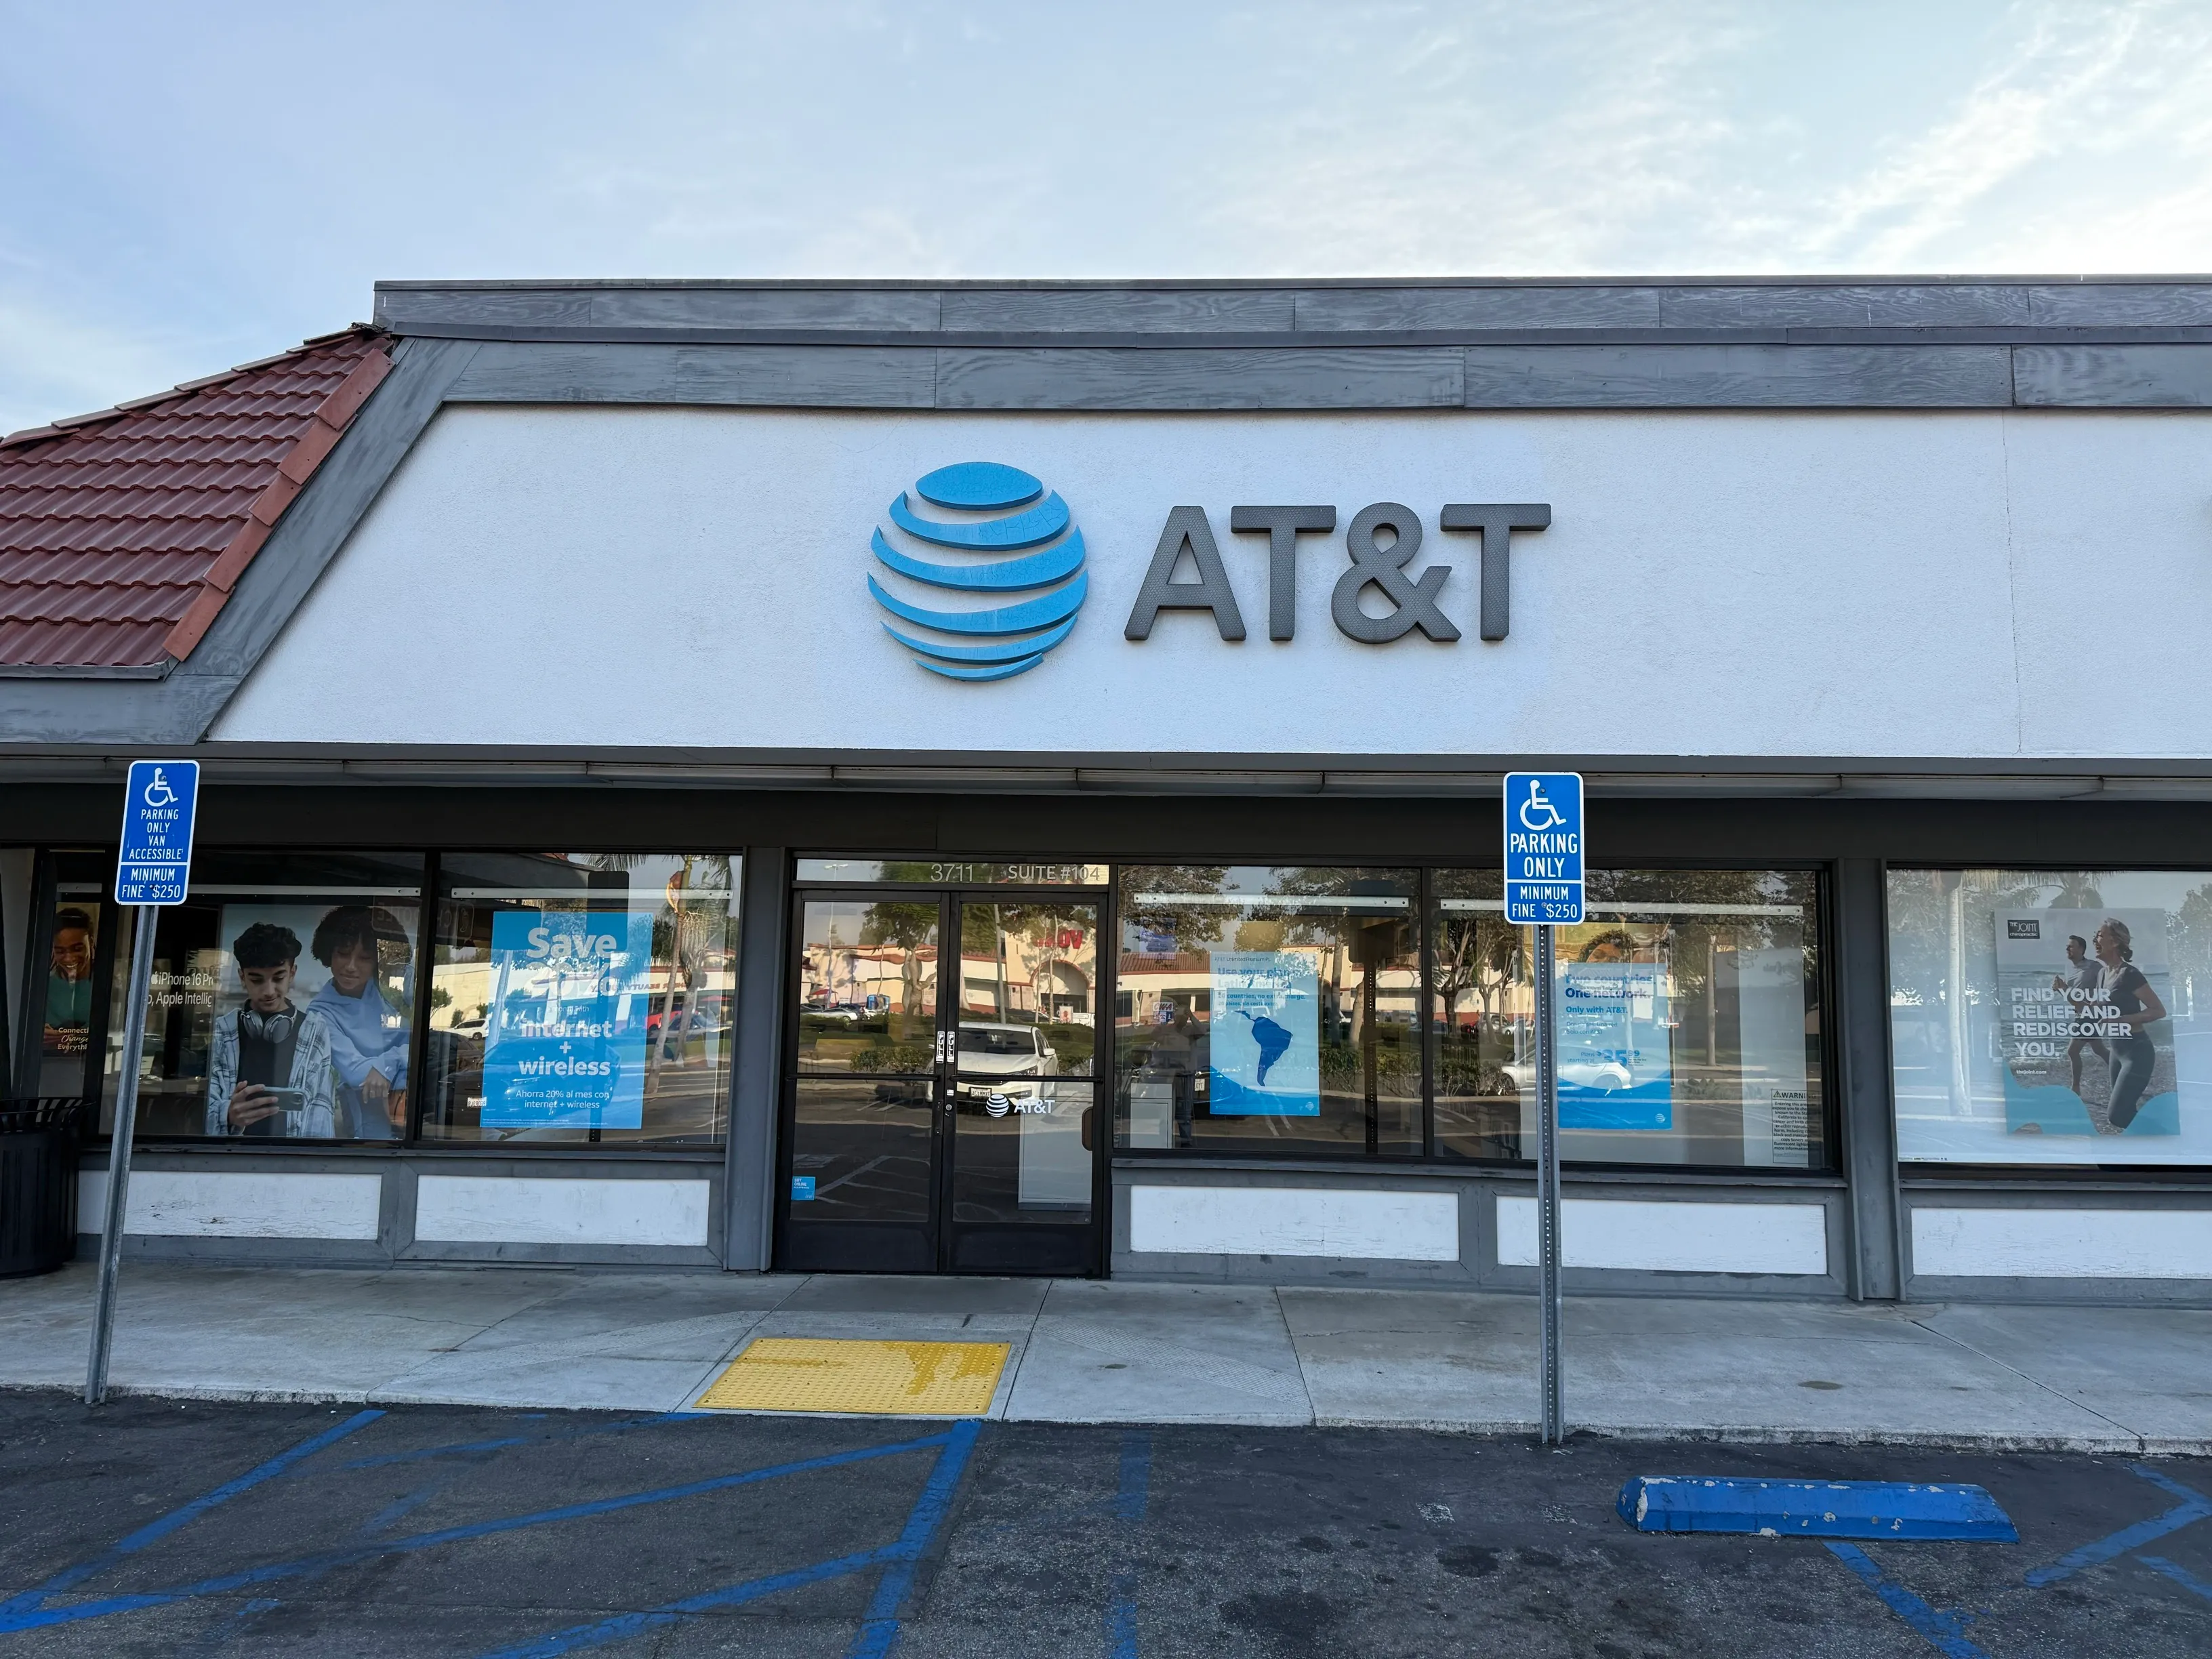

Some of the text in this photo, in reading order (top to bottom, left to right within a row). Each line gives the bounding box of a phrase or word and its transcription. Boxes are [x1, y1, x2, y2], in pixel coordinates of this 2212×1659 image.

[1124, 502, 1551, 643] AT&T
[141, 809, 179, 820] PARKING
[147, 822, 170, 833] ONLY
[149, 836, 165, 846] VAN
[1511, 833, 1578, 854] PARKING
[129, 848, 182, 859] ACCESSIBLE
[131, 868, 175, 881] MINIMUM
[930, 863, 973, 882] 3711
[1008, 865, 1100, 881] SUITE #104
[1524, 857, 1565, 878] ONLY
[122, 884, 180, 899] FINE $250
[1520, 886, 1569, 900] MINIMUM
[1512, 903, 1578, 919] FINE $250
[2017, 922, 2037, 932] JOINT
[526, 927, 617, 958] Save
[159, 972, 190, 985] iPhone
[192, 973, 201, 985] 16
[1240, 969, 1265, 977] your
[1565, 974, 1591, 983] Two
[156, 991, 183, 1007] Apple
[184, 991, 212, 1007] Intellig
[1565, 987, 1591, 998] One
[2011, 988, 2111, 1002] FIND YOUR
[1565, 1006, 1584, 1015] Only
[2012, 1005, 2121, 1019] RELIEF AND
[520, 1018, 613, 1038] internet
[2013, 1022, 2133, 1037] REDISCOVER
[559, 1041, 571, 1054] +
[2015, 1042, 2060, 1057] YOU.
[518, 1055, 611, 1076] wireless
[525, 1100, 557, 1108] internet
[1014, 1099, 1055, 1113] AT&T
